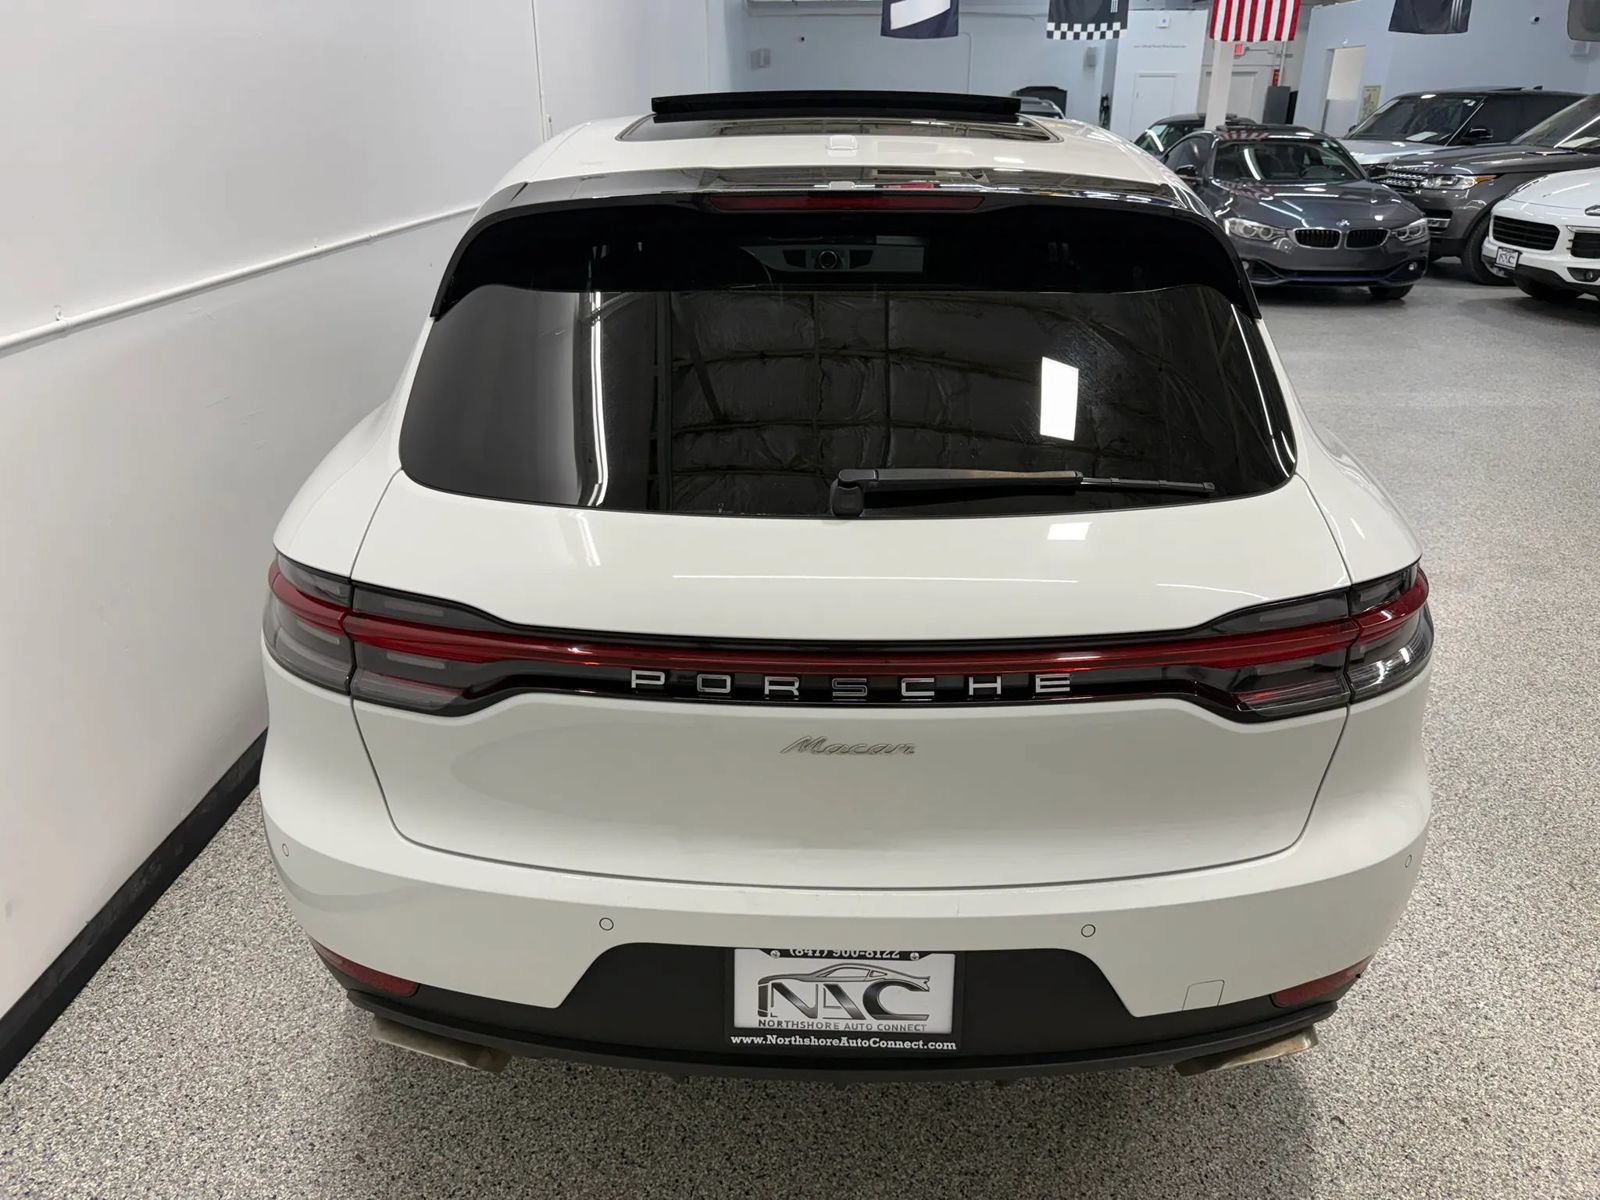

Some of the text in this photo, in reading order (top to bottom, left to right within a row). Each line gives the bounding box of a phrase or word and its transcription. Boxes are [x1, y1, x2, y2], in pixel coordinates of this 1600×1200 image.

[630, 670, 1072, 697] PORSCHE
[780, 736, 915, 755] Macan
[758, 1019, 928, 1033] NORTHSHORE AUTO CONNECT
[730, 1034, 957, 1050] www.NorthshoreAutoConnect.com
